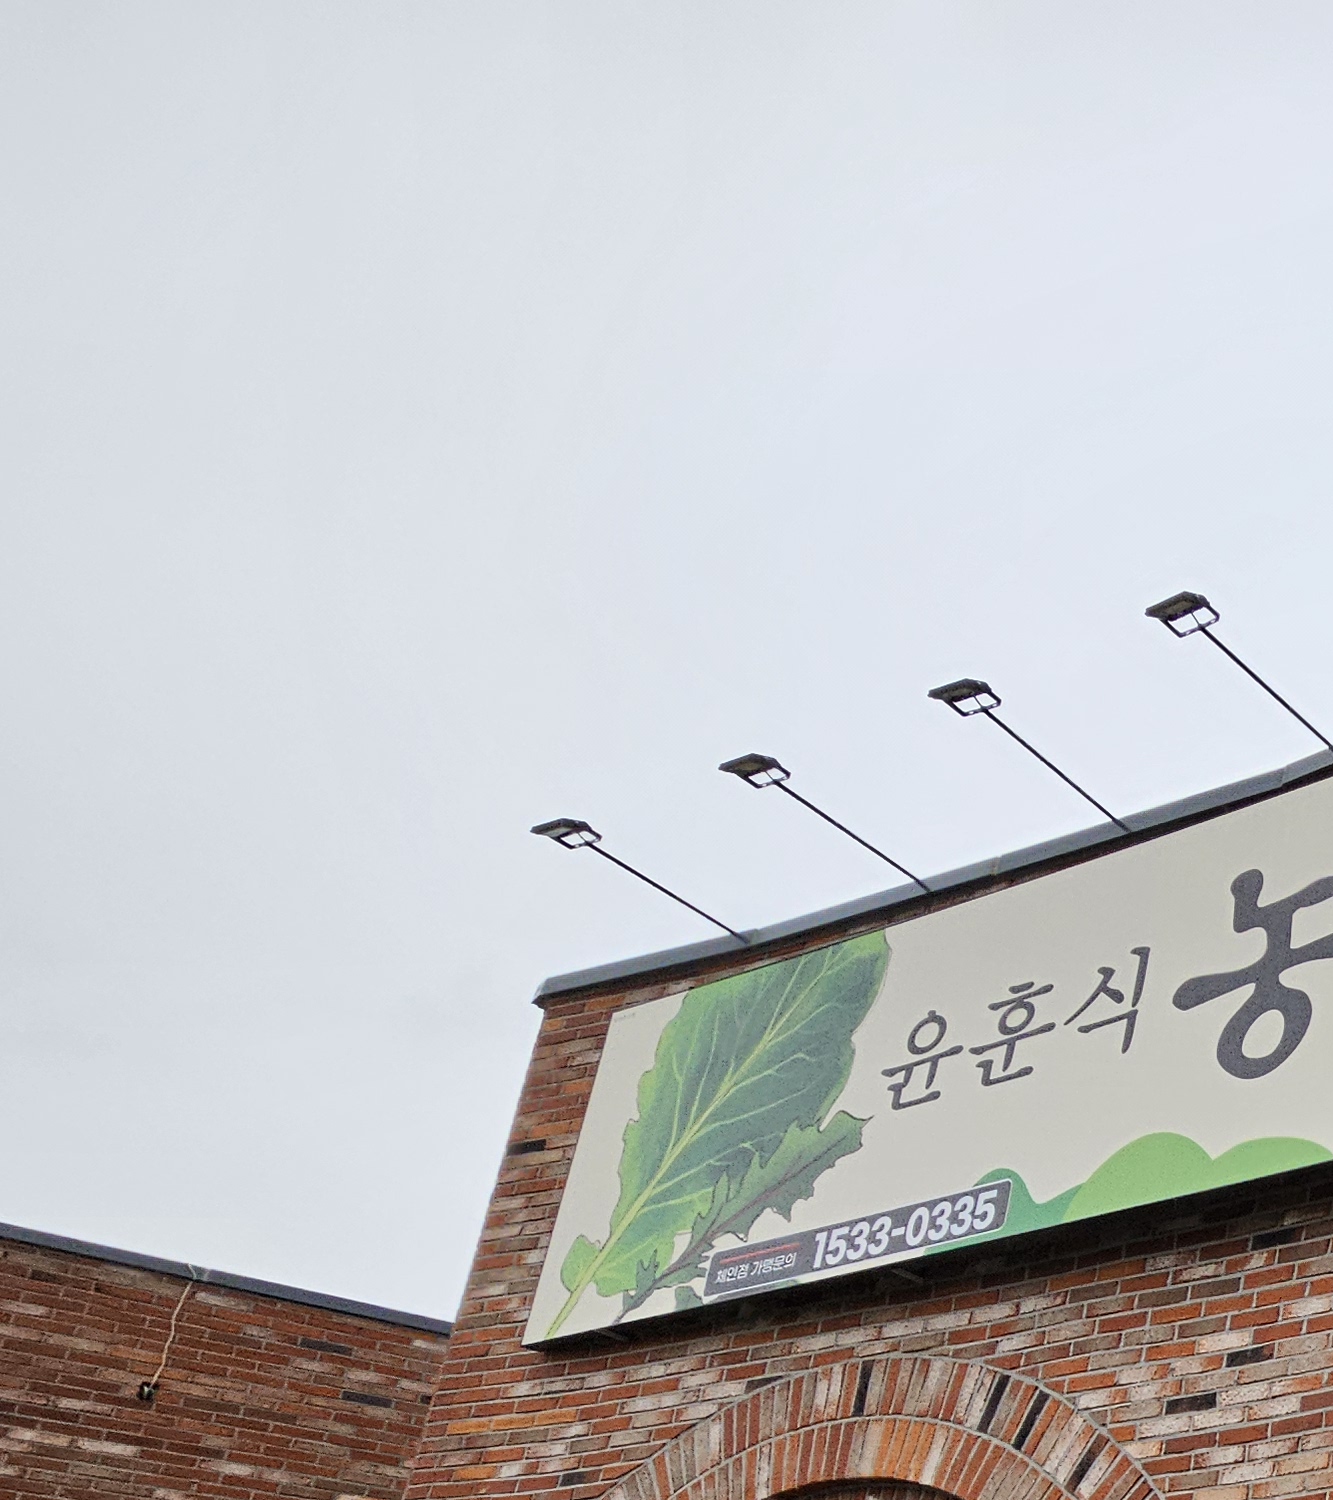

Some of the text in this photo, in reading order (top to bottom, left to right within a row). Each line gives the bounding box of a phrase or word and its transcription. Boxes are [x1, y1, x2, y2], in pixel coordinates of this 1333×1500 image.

[880, 946, 1151, 1110] 윤훈식
[715, 1251, 798, 1285] 체인점 가맹문의
[812, 1189, 998, 1271] 1533-0335
